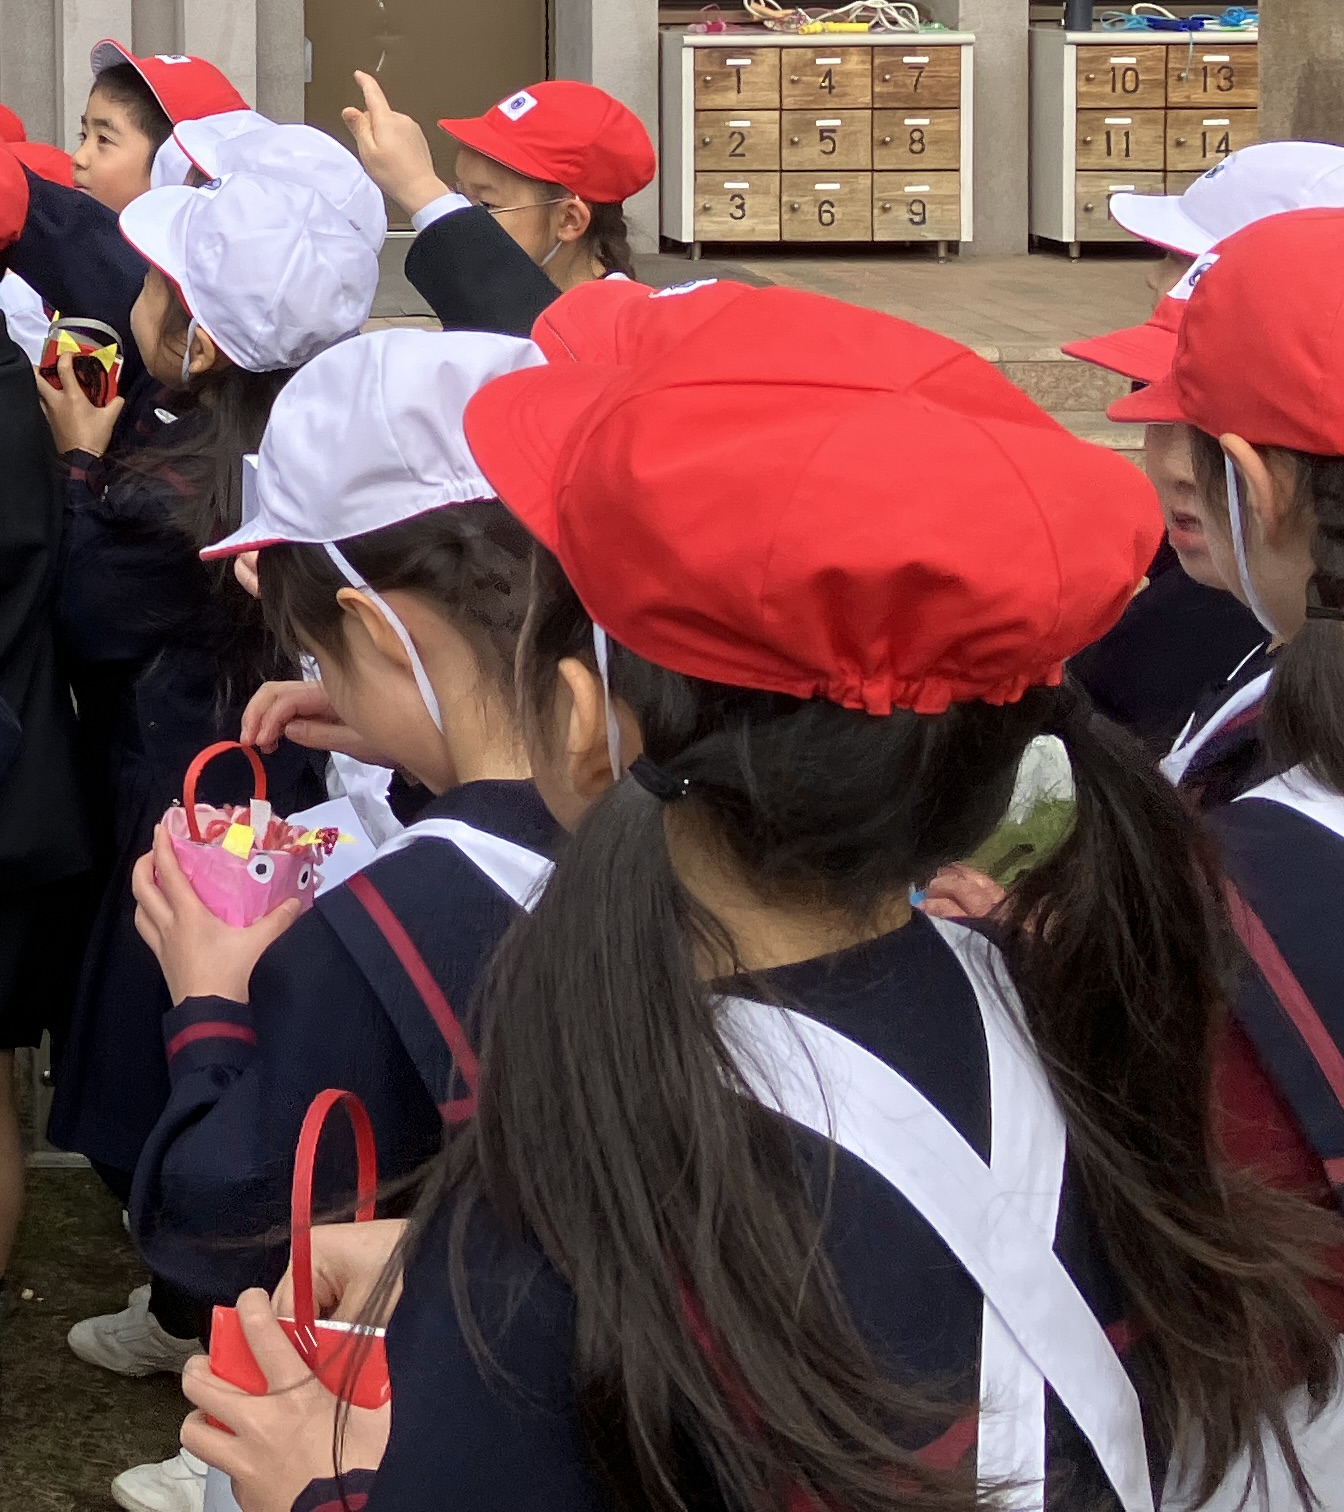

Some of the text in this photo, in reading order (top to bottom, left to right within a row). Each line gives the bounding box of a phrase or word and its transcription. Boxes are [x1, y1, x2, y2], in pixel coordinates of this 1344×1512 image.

[733, 67, 742, 95] 1
[818, 68, 836, 95] 4
[907, 66, 924, 93] 7
[1109, 66, 1140, 94] 10
[1201, 65, 1234, 93] 13
[728, 130, 746, 158] 2
[818, 128, 837, 155] 5
[908, 128, 926, 155] 8
[1104, 130, 1131, 158] 11
[1200, 131, 1233, 159] 14
[729, 193, 746, 221] 3
[818, 199, 835, 227] 6
[909, 199, 927, 226] 9
